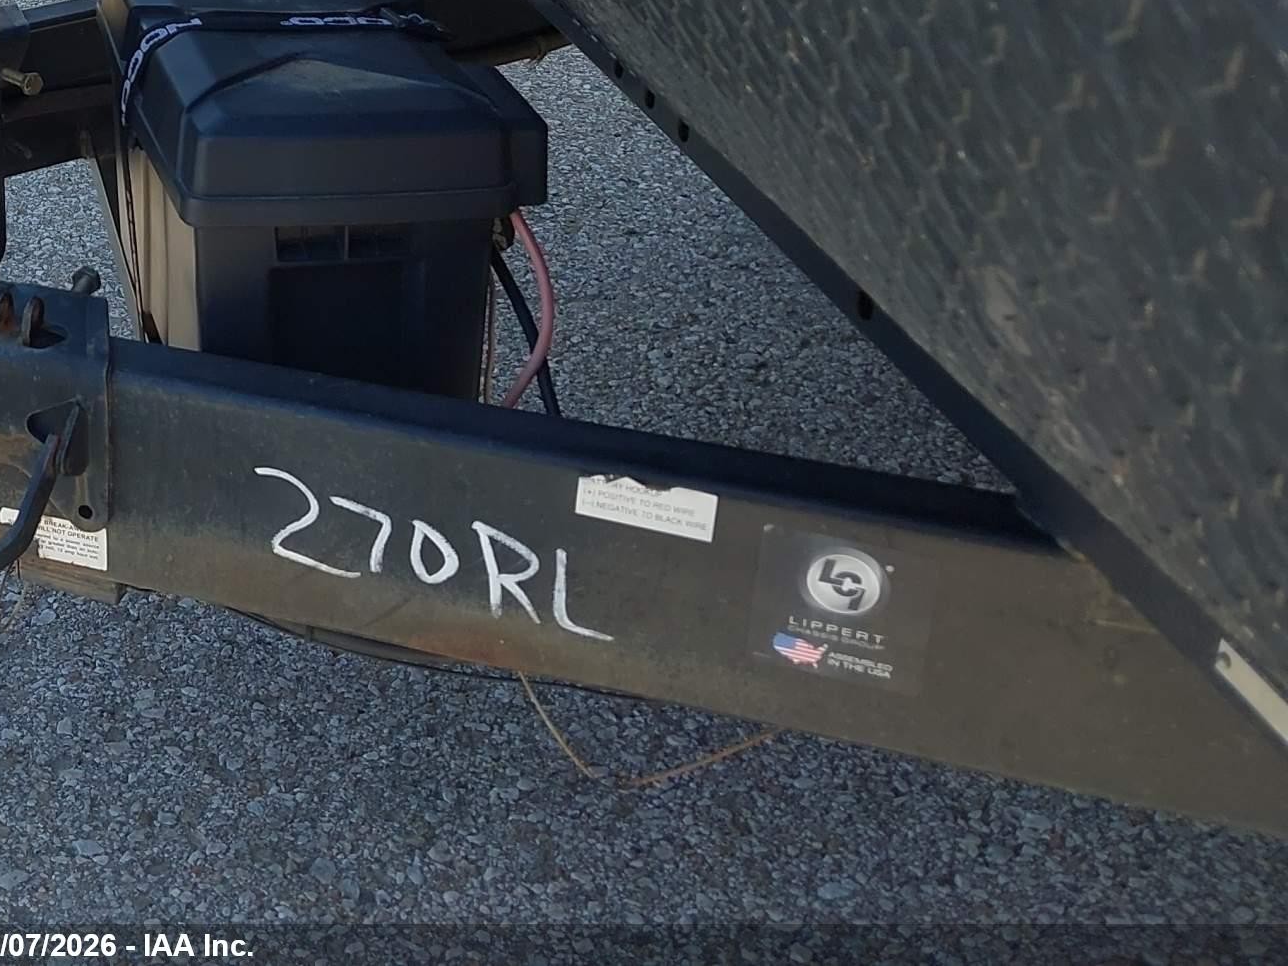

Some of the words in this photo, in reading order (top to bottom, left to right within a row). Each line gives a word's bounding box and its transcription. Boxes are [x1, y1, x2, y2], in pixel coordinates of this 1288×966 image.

[598, 490, 636, 504] POSITIVE
[639, 498, 651, 508] TO
[596, 500, 637, 516] NEGATIVE
[642, 510, 653, 520] TO
[654, 514, 682, 526] BLACK
[52, 528, 66, 536] NOT
[67, 531, 99, 542] OPERATE
[788, 615, 886, 644] LIPPERT
[828, 651, 894, 672] ASSEMBLED
[842, 660, 865, 673] THE
[866, 665, 892, 679] USA
